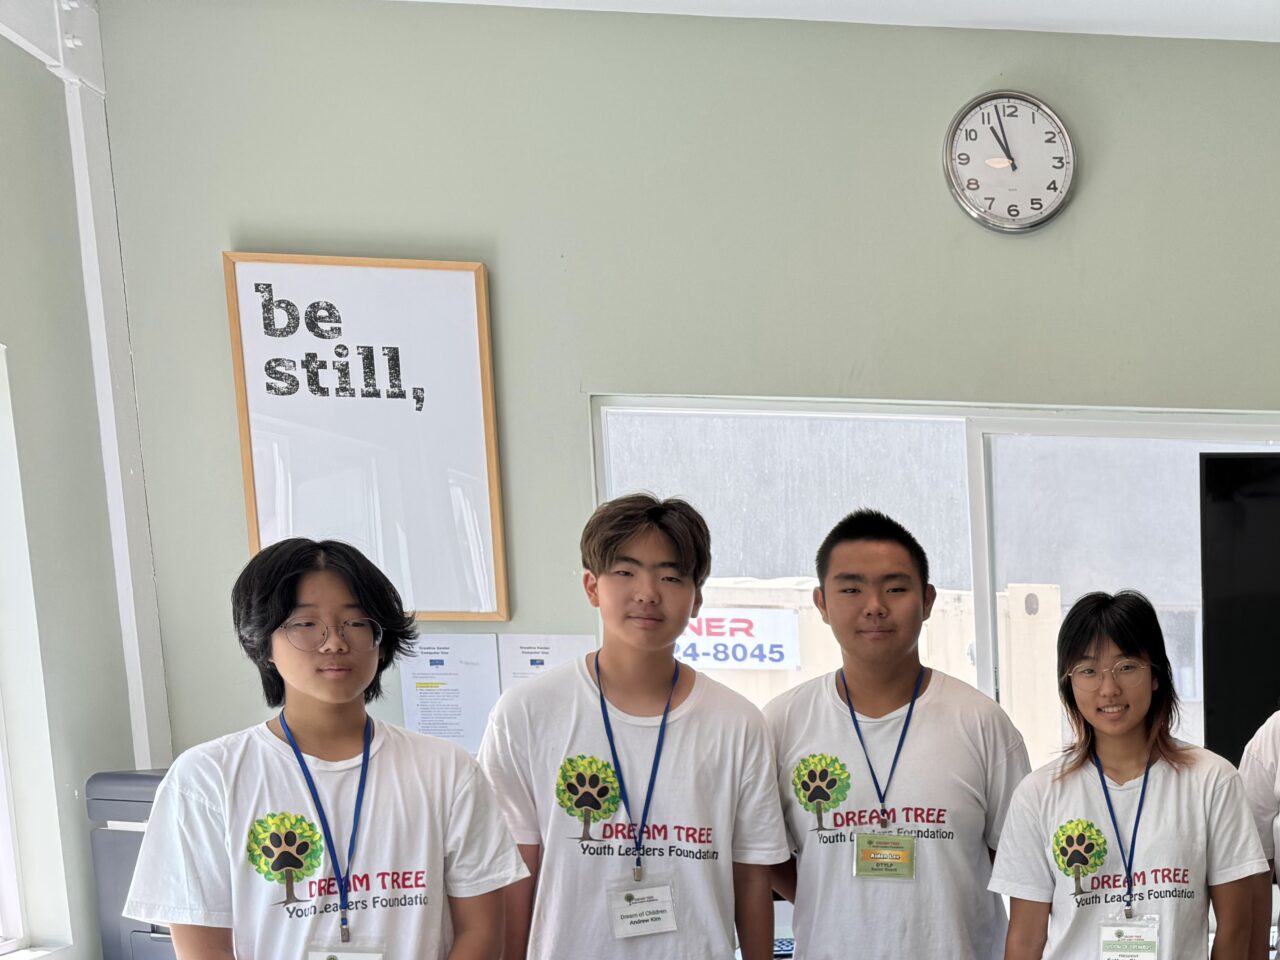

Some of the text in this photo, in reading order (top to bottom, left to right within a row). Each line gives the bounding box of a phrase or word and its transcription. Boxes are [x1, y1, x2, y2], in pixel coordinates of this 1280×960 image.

[981, 111, 991, 125] 11
[1002, 104, 1019, 118] 12
[1031, 111, 1036, 125] 1
[965, 128, 978, 141] 10
[1044, 131, 1057, 143] 2
[957, 152, 971, 166] 9
[1052, 156, 1065, 169] 3
[966, 178, 980, 191] 8
[1046, 179, 1058, 193] 4
[983, 197, 996, 210] 7
[1007, 204, 1020, 217] 6
[1030, 198, 1043, 211] 5
[254, 282, 342, 339] be
[264, 343, 425, 412] still,
[902, 807, 947, 824] TREE
[673, 825, 713, 844] TREE
[818, 831, 846, 844] Youth
[580, 843, 614, 856] Youth
[1151, 868, 1189, 885] TREE
[308, 871, 427, 898] DREM TREE
[319, 900, 368, 915] eaers
[372, 894, 428, 909] Foundatio
[1075, 895, 1101, 908] Youth
[1147, 887, 1195, 900] Foundation
